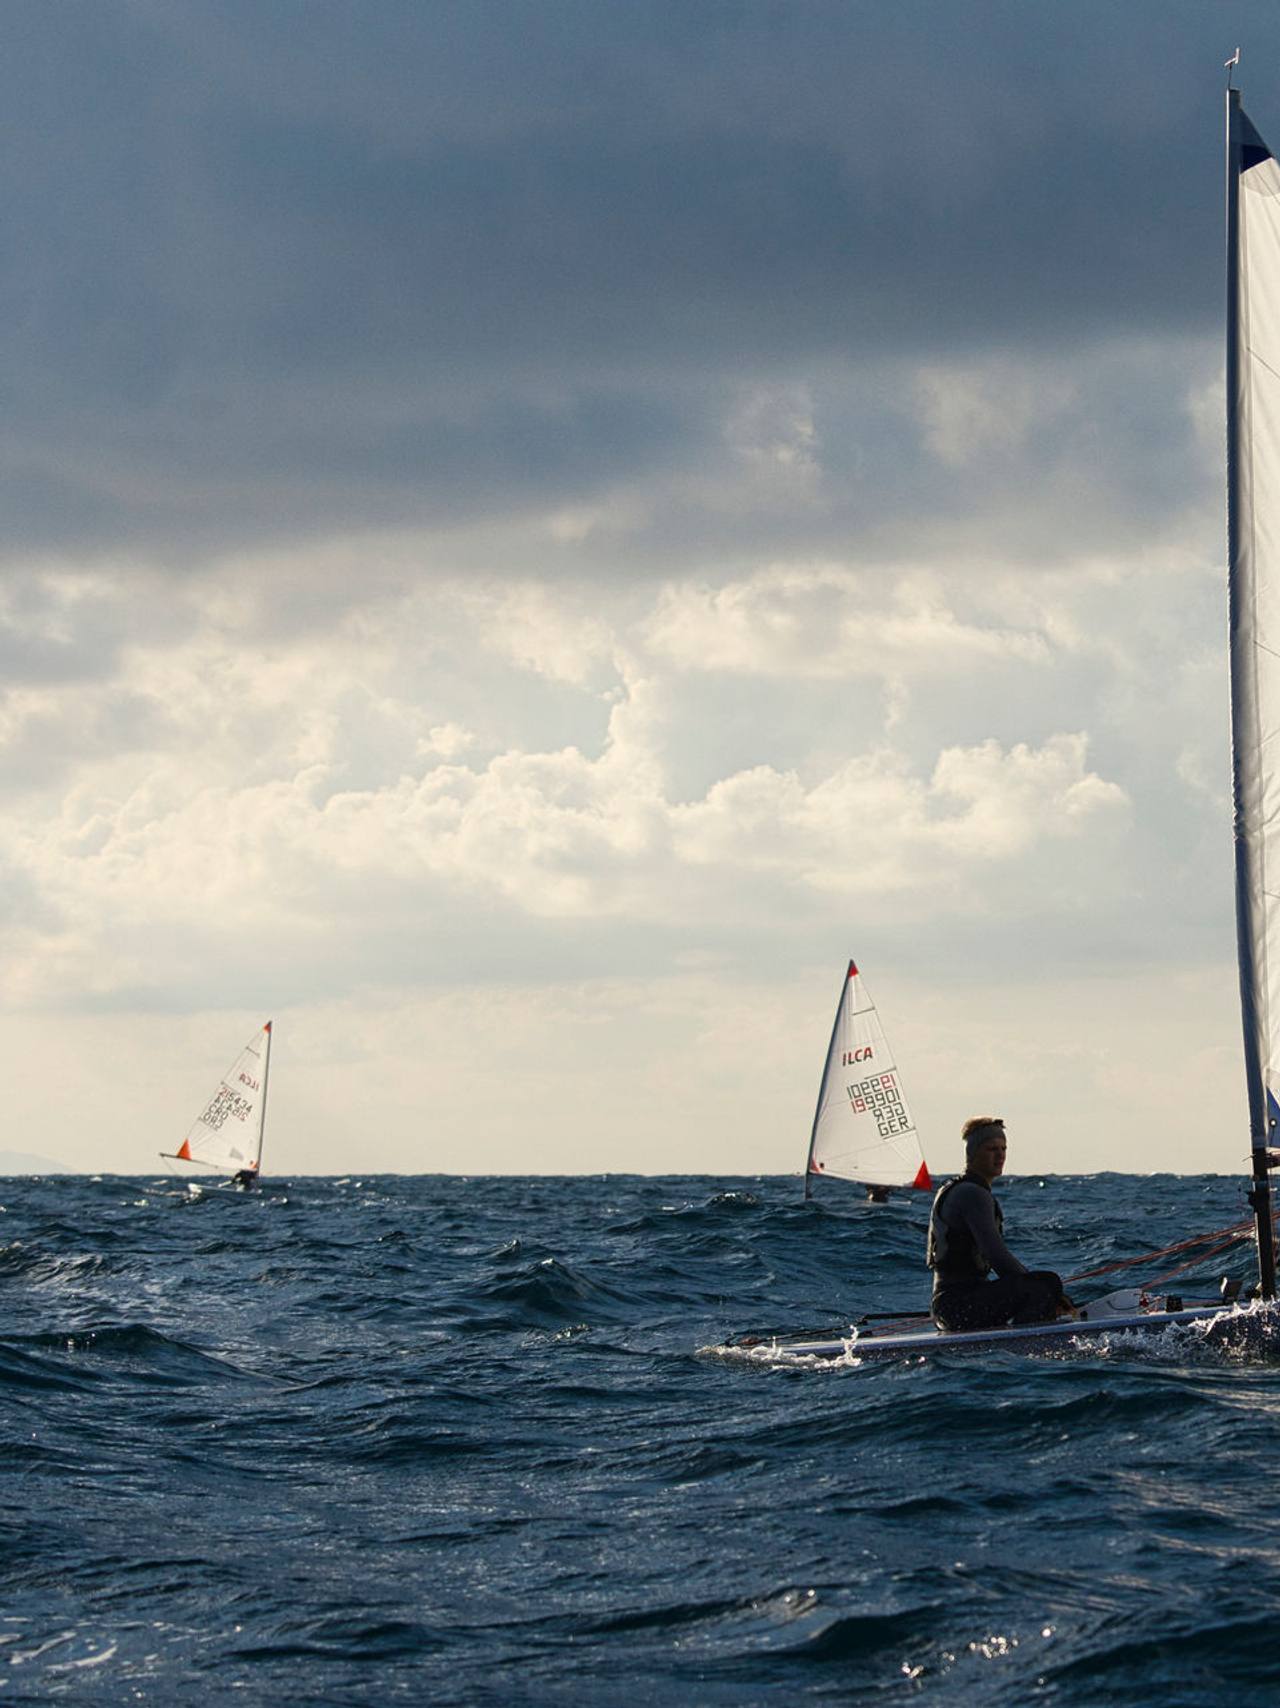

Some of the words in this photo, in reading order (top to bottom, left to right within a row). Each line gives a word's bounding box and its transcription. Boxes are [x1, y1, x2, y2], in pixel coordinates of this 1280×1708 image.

[842, 1047, 873, 1067] ILCA
[851, 1088, 901, 1114] 199901
[208, 1104, 229, 1121] CRO
[877, 1115, 909, 1137] GER
